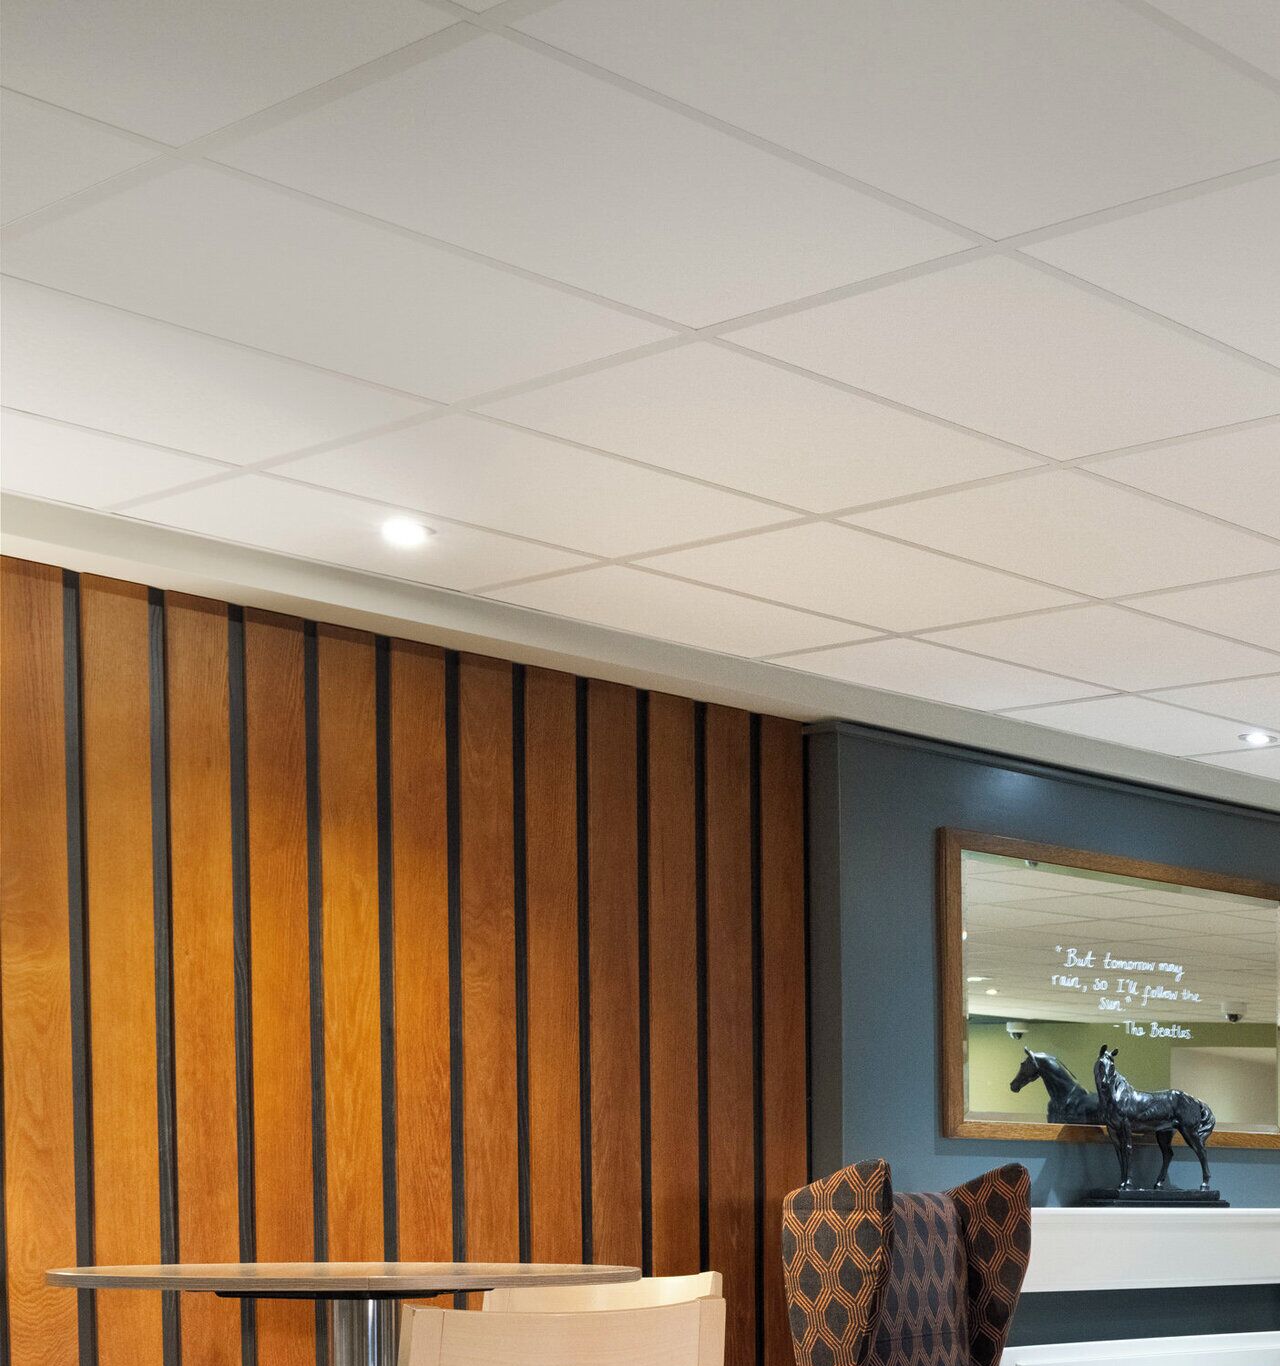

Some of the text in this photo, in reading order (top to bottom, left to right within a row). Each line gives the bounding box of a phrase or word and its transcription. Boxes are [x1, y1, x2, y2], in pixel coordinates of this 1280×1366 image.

[1103, 952, 1156, 972] tomorrow
[1158, 962, 1186, 983] may
[1051, 974, 1203, 1007] rain, so I'll follow the
[1122, 1020, 1146, 1037] The
